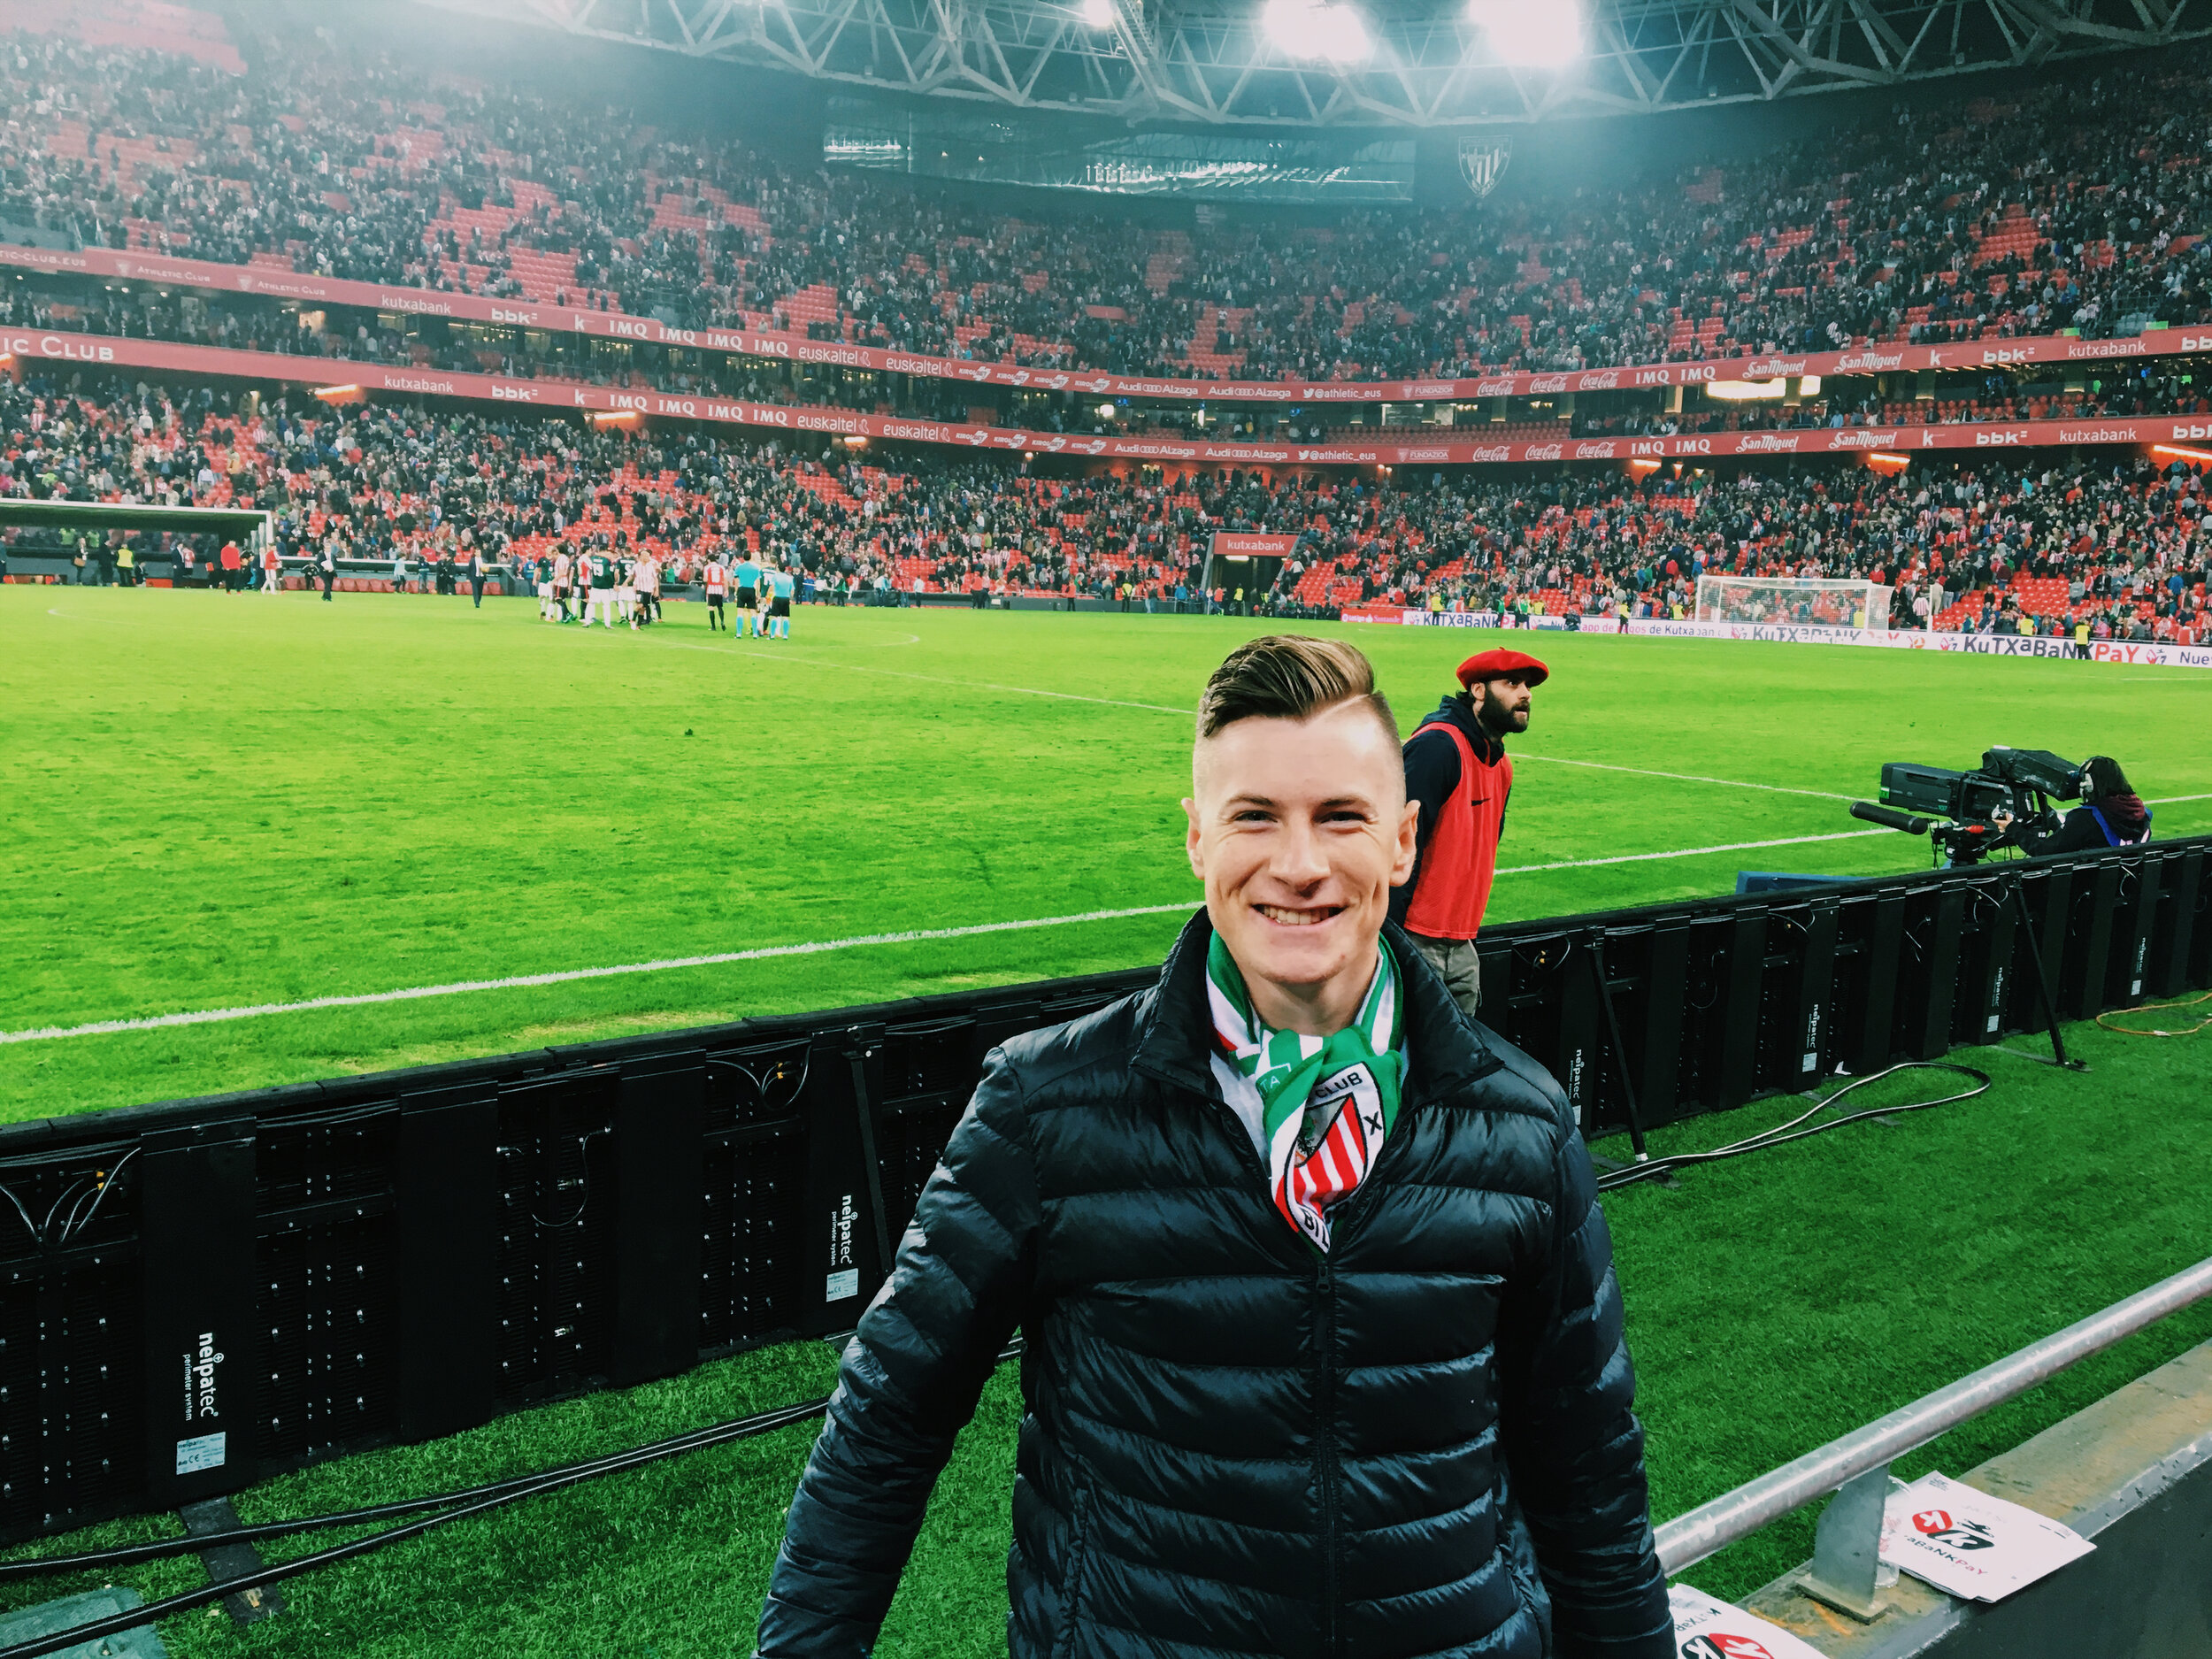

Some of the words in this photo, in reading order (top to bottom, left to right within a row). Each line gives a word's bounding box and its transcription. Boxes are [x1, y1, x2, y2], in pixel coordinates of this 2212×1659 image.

[381, 295, 451, 314] kutxabank
[610, 319, 649, 341] IMQ
[659, 326, 696, 346] IMQ
[41, 335, 114, 361] CLUB
[707, 333, 743, 352] IMQ
[754, 339, 789, 357] IMQ
[2068, 340, 2147, 358] kutxabank
[798, 346, 858, 365] euskaltel
[886, 357, 941, 374] euskaltel
[1680, 365, 1717, 381] IMQ
[384, 374, 454, 393] kutxabank
[1635, 369, 1671, 385] IMQ
[1117, 381, 1142, 391] Audi
[1162, 384, 1198, 396] Alzaga
[1208, 386, 1234, 396] Audi
[1255, 388, 1291, 399] Alzaga
[1314, 388, 1381, 399] @athletic_eus
[610, 394, 649, 412] IMQ
[658, 399, 696, 418] IMQ
[707, 403, 744, 422] IMQ
[753, 409, 788, 426] IMQ
[797, 415, 856, 432] euskaltel
[883, 424, 939, 441] euskaltel
[2059, 427, 2137, 442] kutxabank
[1115, 443, 1139, 453] Audi
[1159, 445, 1195, 457] Alzaga
[1205, 448, 1231, 457] Audi
[1252, 449, 1287, 461] Alzaga
[1310, 449, 1376, 461] @athletic_eus
[1631, 441, 1666, 456] IMQ
[1676, 439, 1712, 454] IMQ
[1227, 539, 1285, 550] kutxabank
[1582, 624, 1600, 634] app
[1602, 623, 1615, 633] de
[1649, 625, 1662, 634] de
[2180, 651, 2212, 665] Nue
[1315, 1072, 1363, 1098] CLUB
[837, 1194, 858, 1263] neipatec
[182, 1353, 192, 1391] perimeter
[193, 1332, 224, 1417] neipatec
